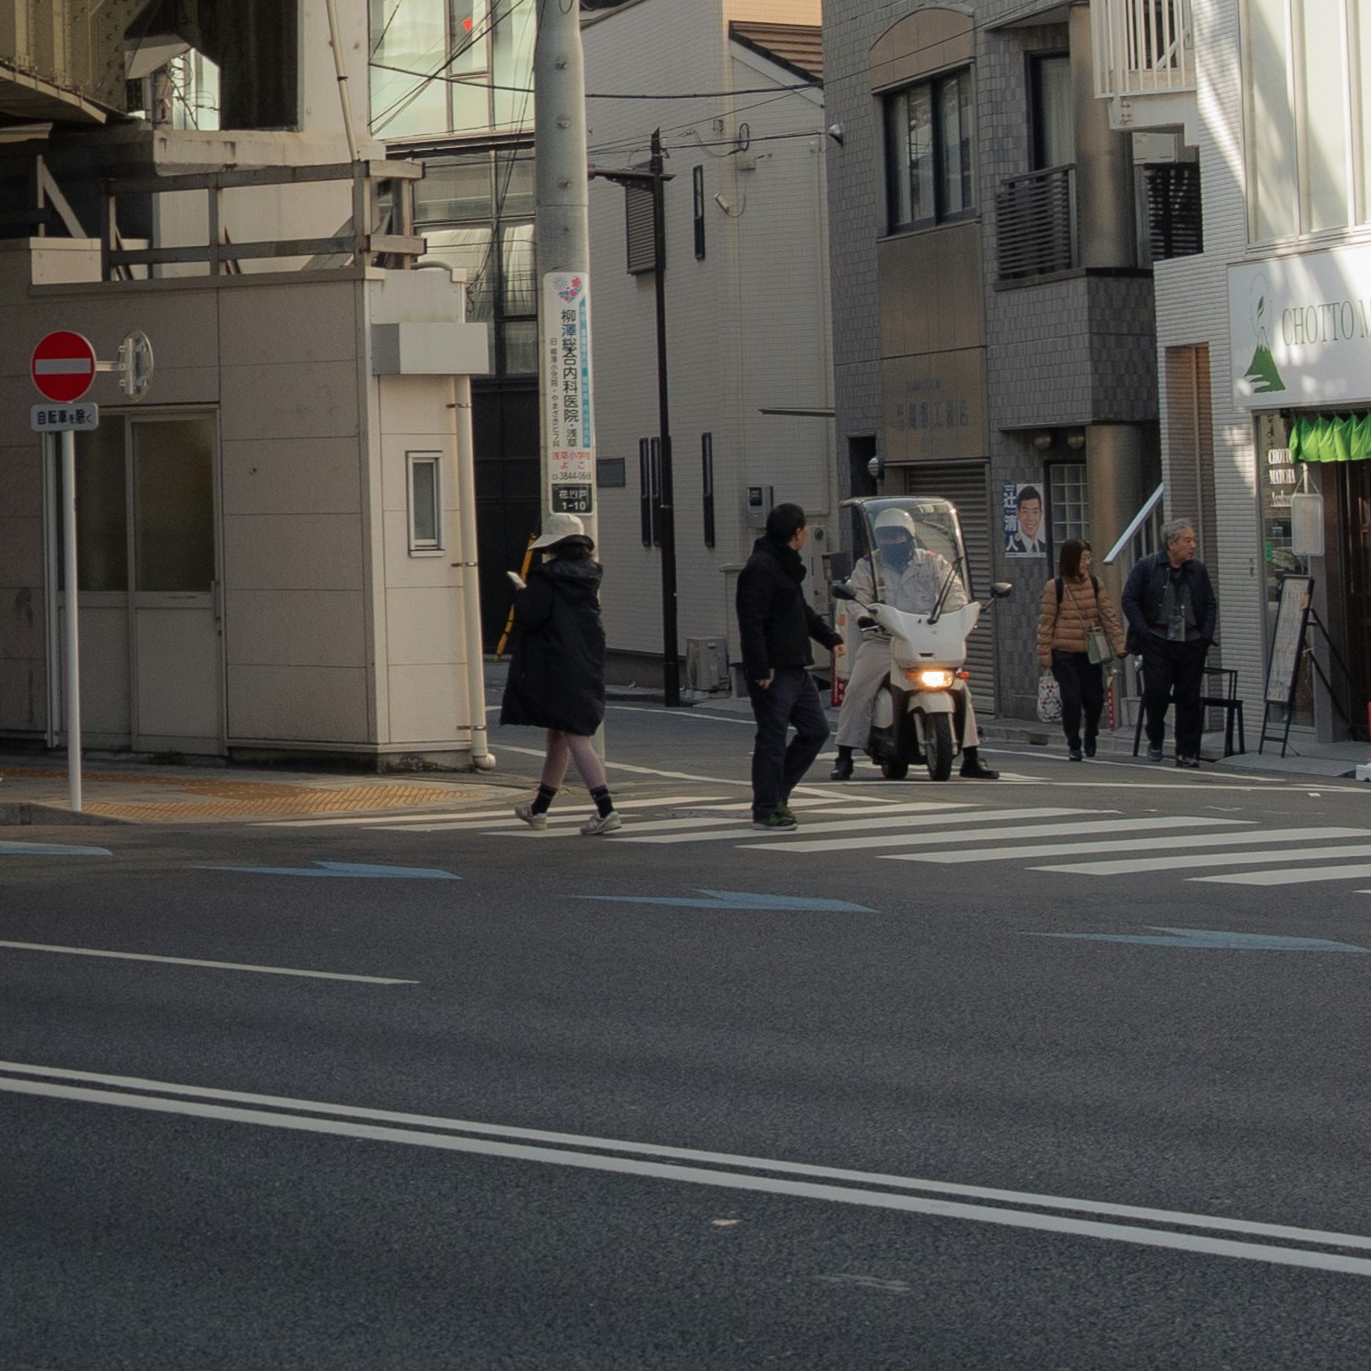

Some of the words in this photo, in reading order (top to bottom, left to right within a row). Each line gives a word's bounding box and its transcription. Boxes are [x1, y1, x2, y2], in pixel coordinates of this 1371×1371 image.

[1282, 300, 1355, 347] CHOTTO
[37, 408, 92, 425] 自転車を除く
[562, 501, 586, 510] 1-10
